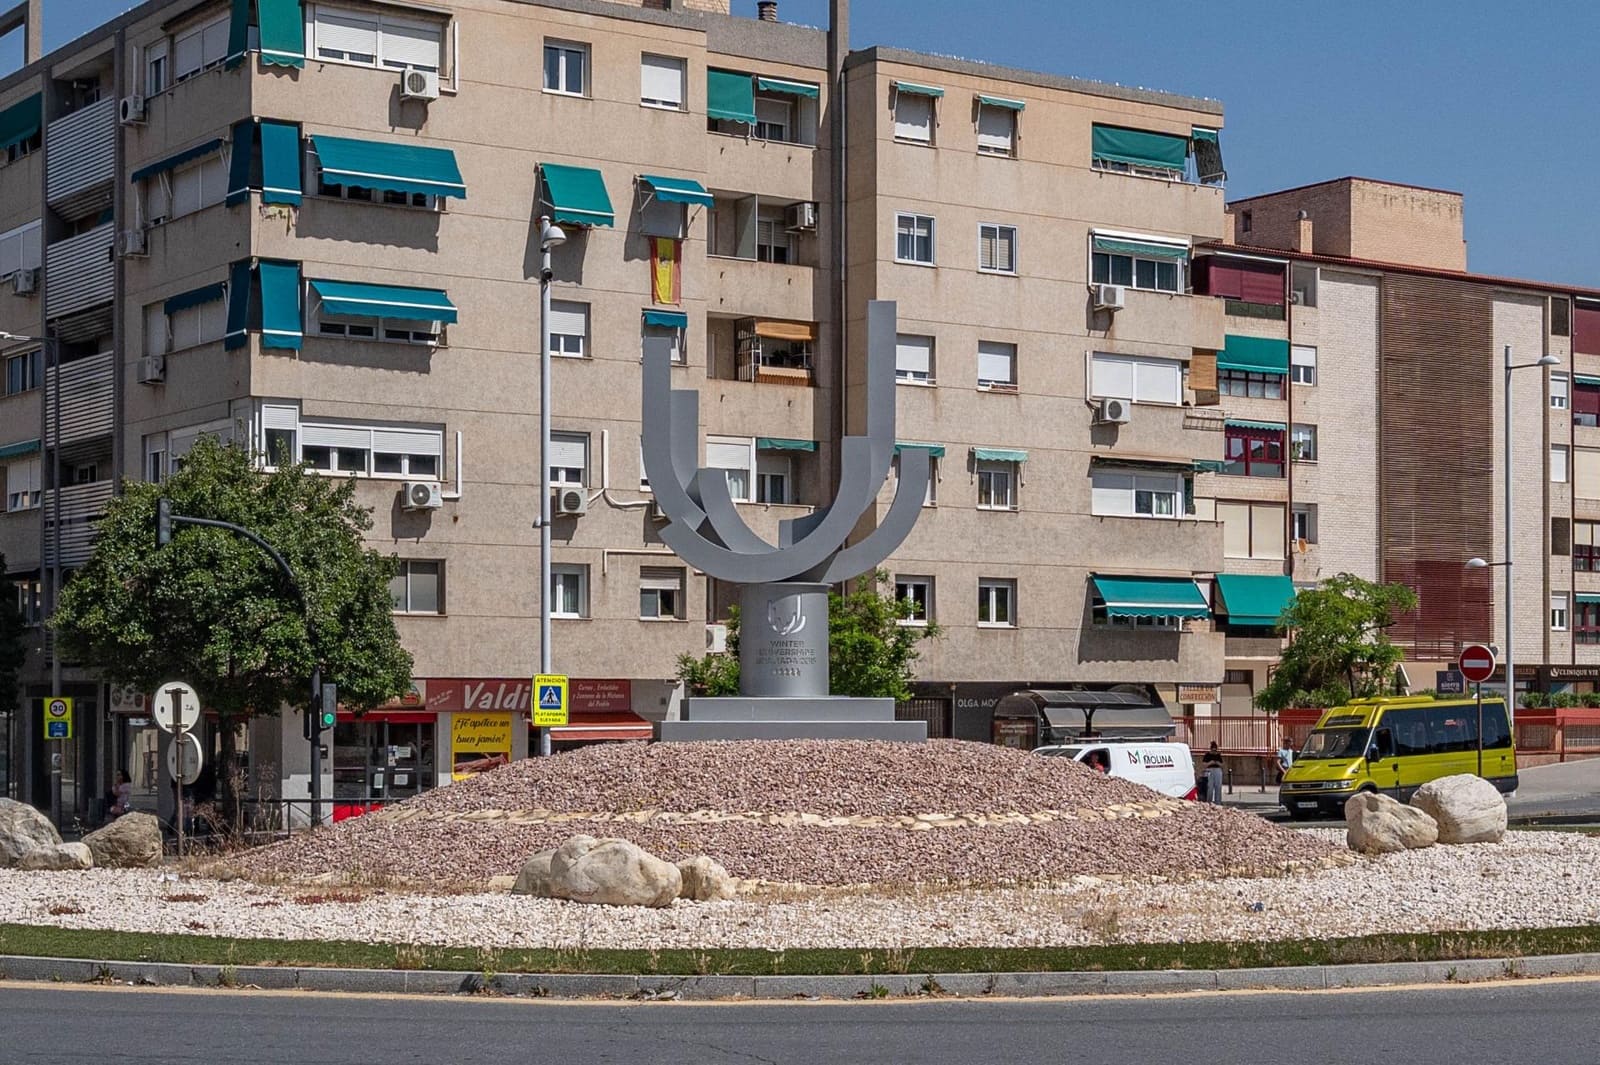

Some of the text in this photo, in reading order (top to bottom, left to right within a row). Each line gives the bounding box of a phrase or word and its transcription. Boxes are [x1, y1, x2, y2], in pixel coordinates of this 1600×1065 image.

[769, 640, 805, 648] WINTER
[1559, 668, 1587, 678] CLINIQUE
[957, 698, 979, 708] OLGA
[456, 734, 475, 744] buen
[1143, 754, 1174, 765] MOLINA
